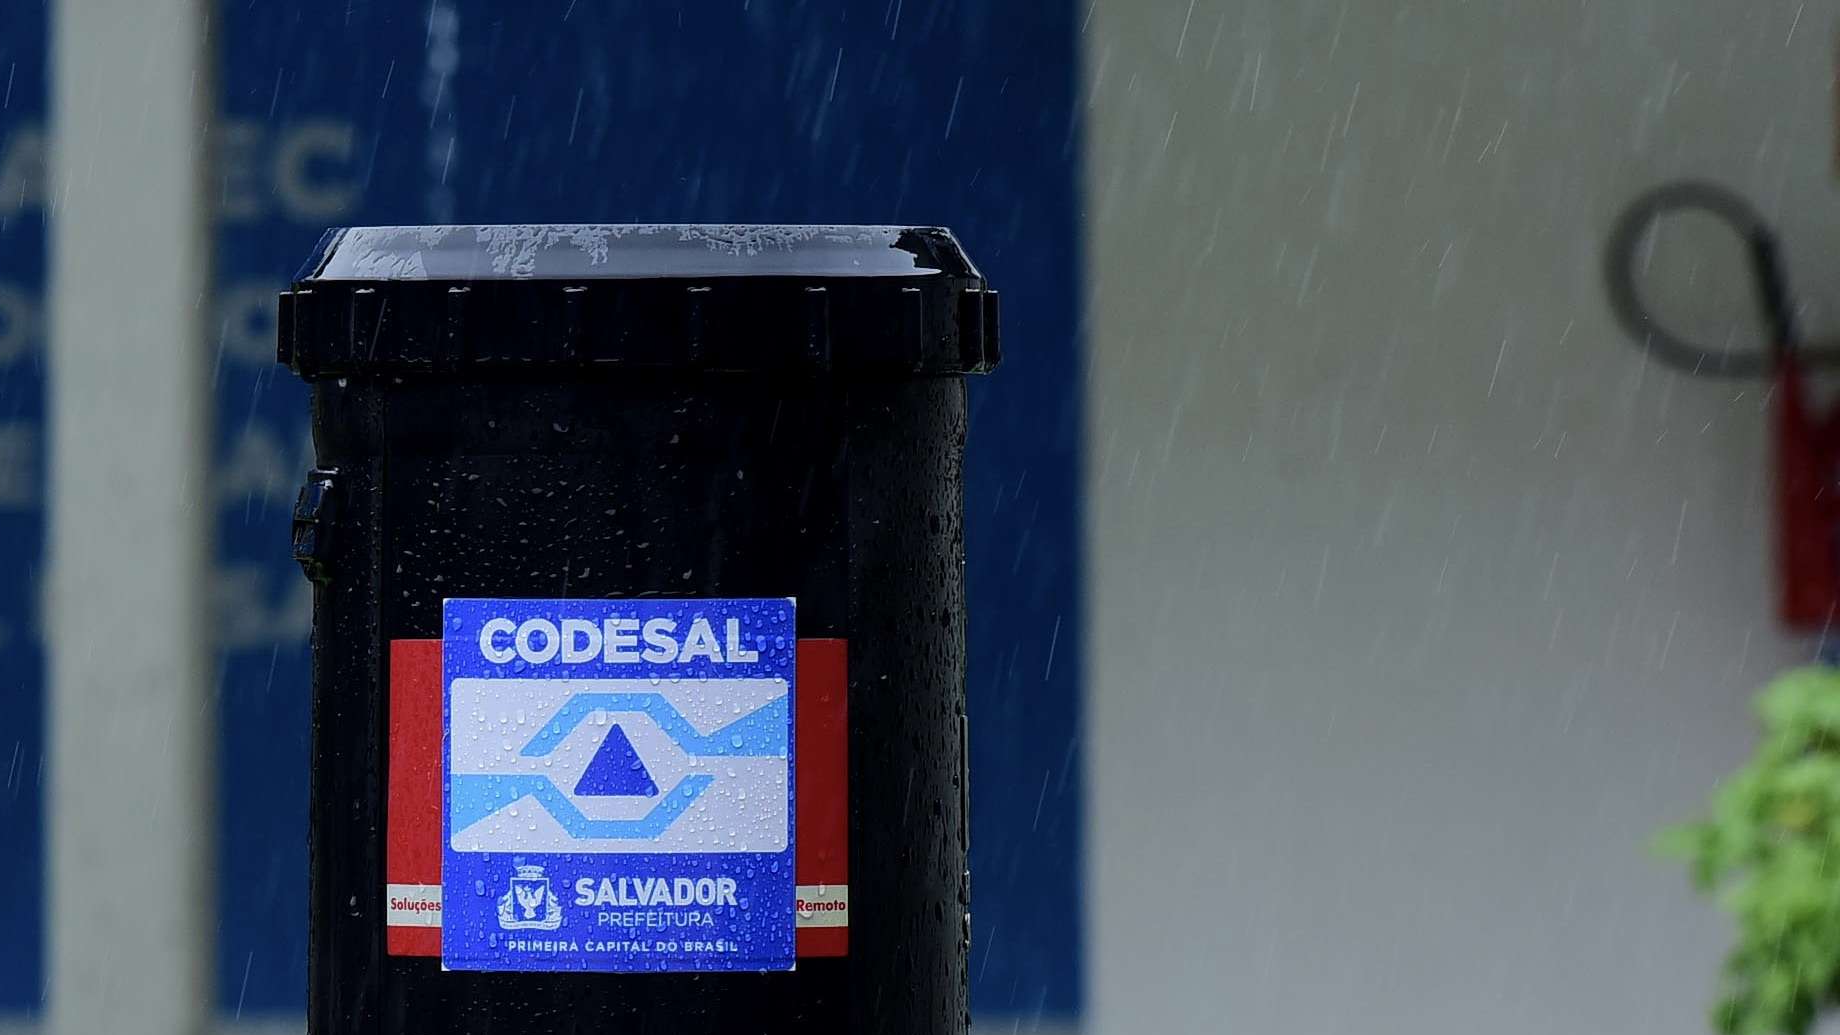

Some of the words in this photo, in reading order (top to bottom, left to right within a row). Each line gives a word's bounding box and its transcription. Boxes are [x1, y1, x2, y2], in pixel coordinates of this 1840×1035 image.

[479, 617, 759, 664] CODESAL
[574, 877, 738, 906] SALVADOR
[390, 897, 442, 914] Soluções
[796, 899, 846, 911] Remoto
[598, 912, 715, 927] PREFEITURA
[508, 941, 579, 952] PRIMEIRA
[585, 941, 650, 952] CAPITAL
[656, 941, 678, 952] DO
[684, 941, 738, 952] BRASIL
